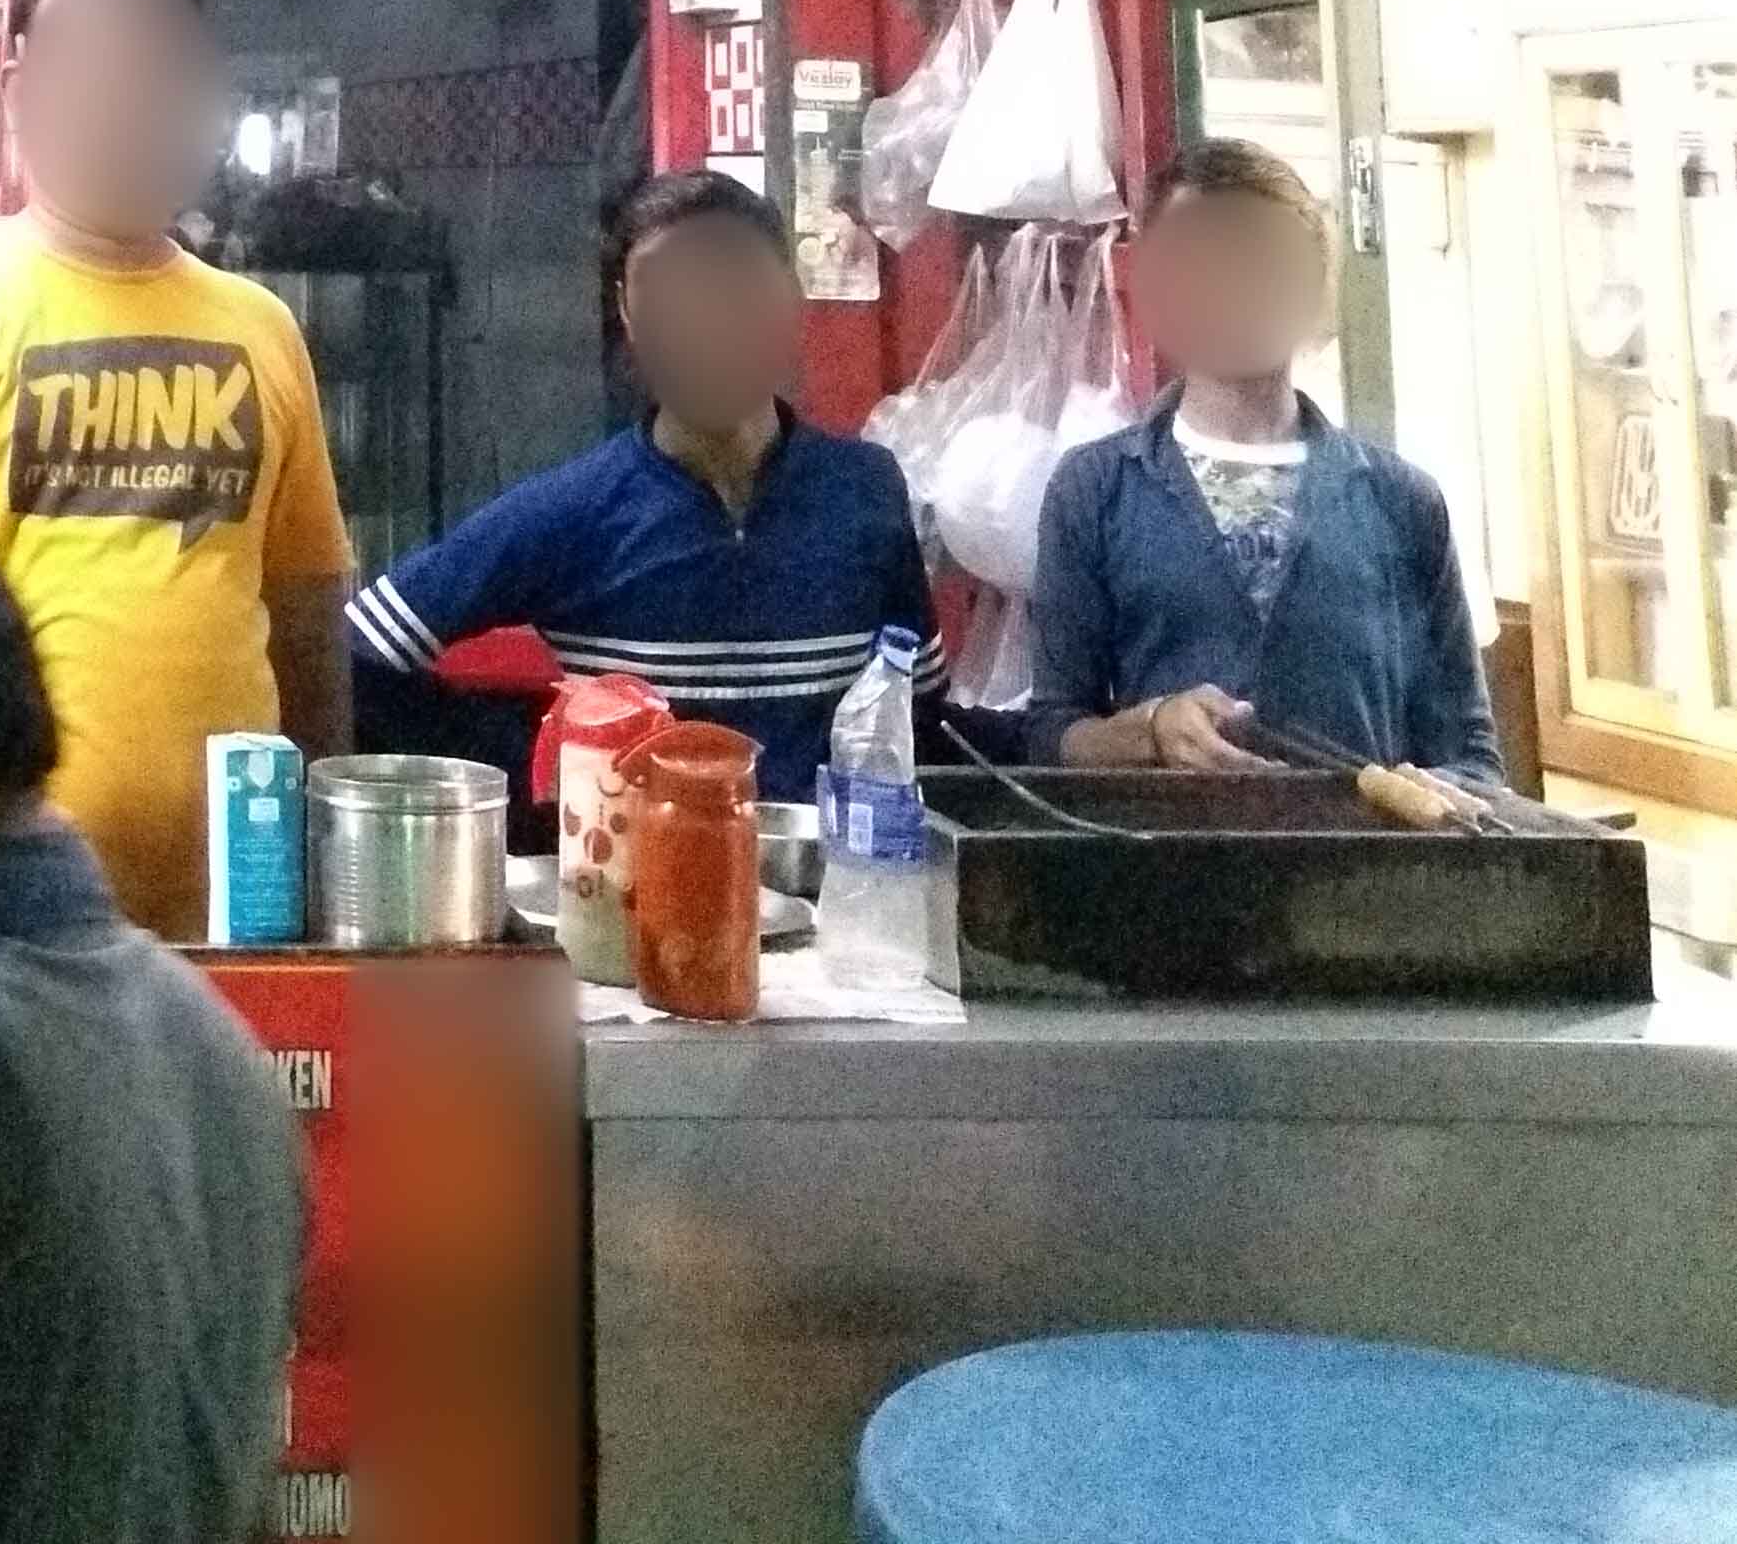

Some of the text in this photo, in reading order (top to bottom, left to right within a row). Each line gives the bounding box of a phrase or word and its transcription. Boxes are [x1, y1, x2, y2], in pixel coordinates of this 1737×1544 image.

[26, 362, 252, 453] THINK
[112, 463, 196, 489] ILLEGAL
[205, 466, 252, 495] YET
